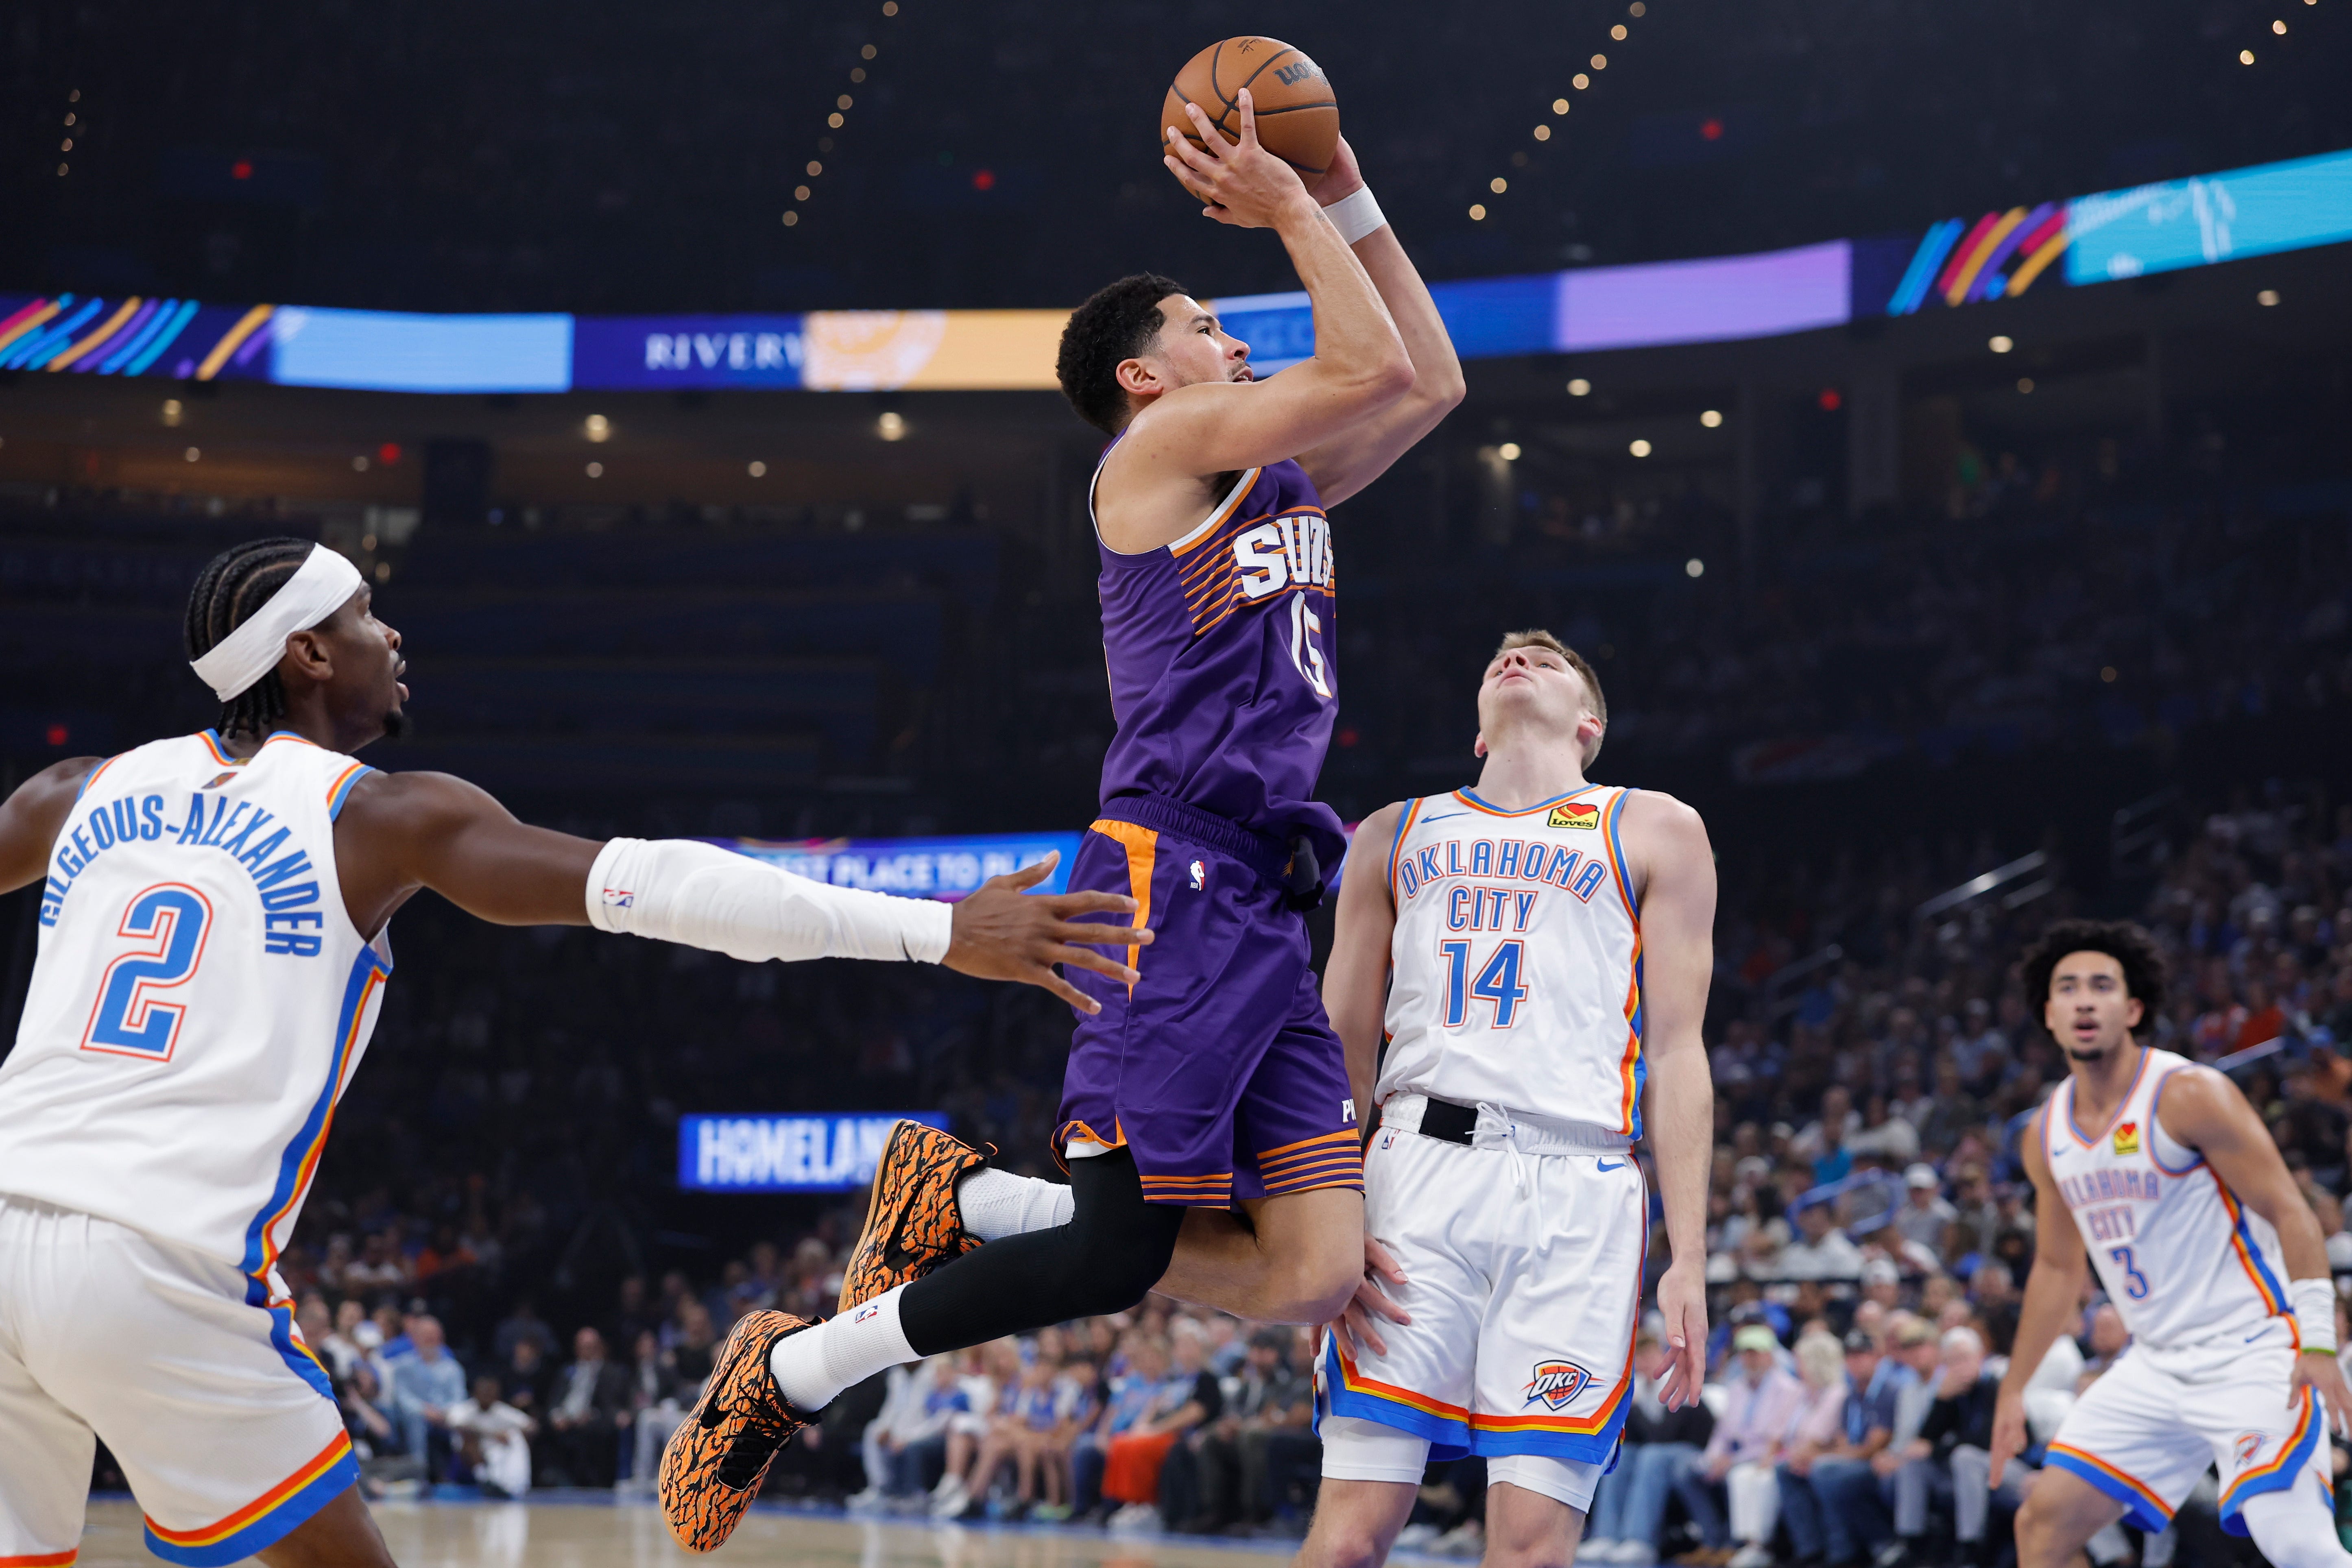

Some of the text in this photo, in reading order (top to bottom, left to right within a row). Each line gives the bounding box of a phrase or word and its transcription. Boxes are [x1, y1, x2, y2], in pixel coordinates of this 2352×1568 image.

[1233, 516, 1334, 599] SUNS
[39, 793, 323, 957] GILGEOUS-ALEXANDER
[1400, 839, 1607, 904] OKLAHOMA
[1447, 885, 1539, 932] CITY
[81, 882, 213, 1062] 2
[1440, 939, 1528, 1029] 14
[2087, 1205, 2134, 1242] CITY
[2109, 1245, 2149, 1302] 3
[1528, 1372, 1578, 1399] OKC
